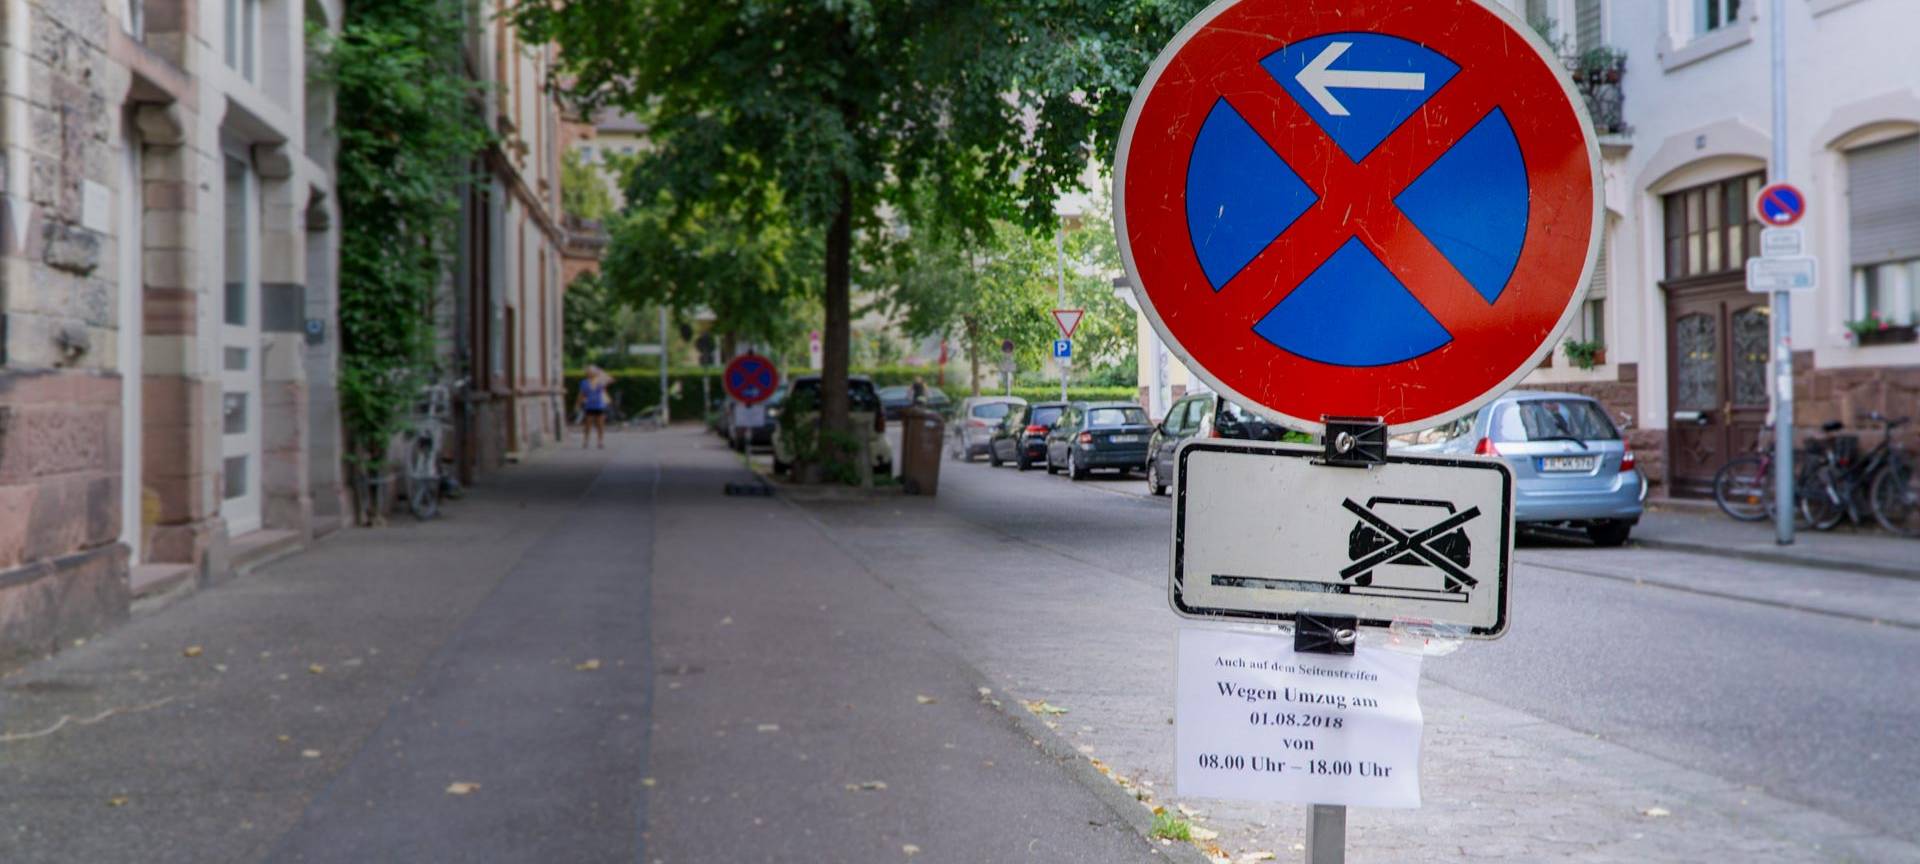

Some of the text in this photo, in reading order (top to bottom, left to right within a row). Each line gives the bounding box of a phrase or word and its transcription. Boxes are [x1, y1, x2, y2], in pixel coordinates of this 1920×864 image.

[1057, 342, 1068, 356] P
[1215, 656, 1378, 681] Auch auf dem Seitenstreifen
[1216, 681, 1378, 709] Wegen Umzug am
[1250, 712, 1343, 729] 01.08.2018
[1283, 738, 1314, 750] von
[1199, 753, 1245, 770] 08.00
[1251, 756, 1286, 772] Uhr
[1309, 759, 1352, 775] 18.00
[1359, 761, 1392, 777] Uhr
